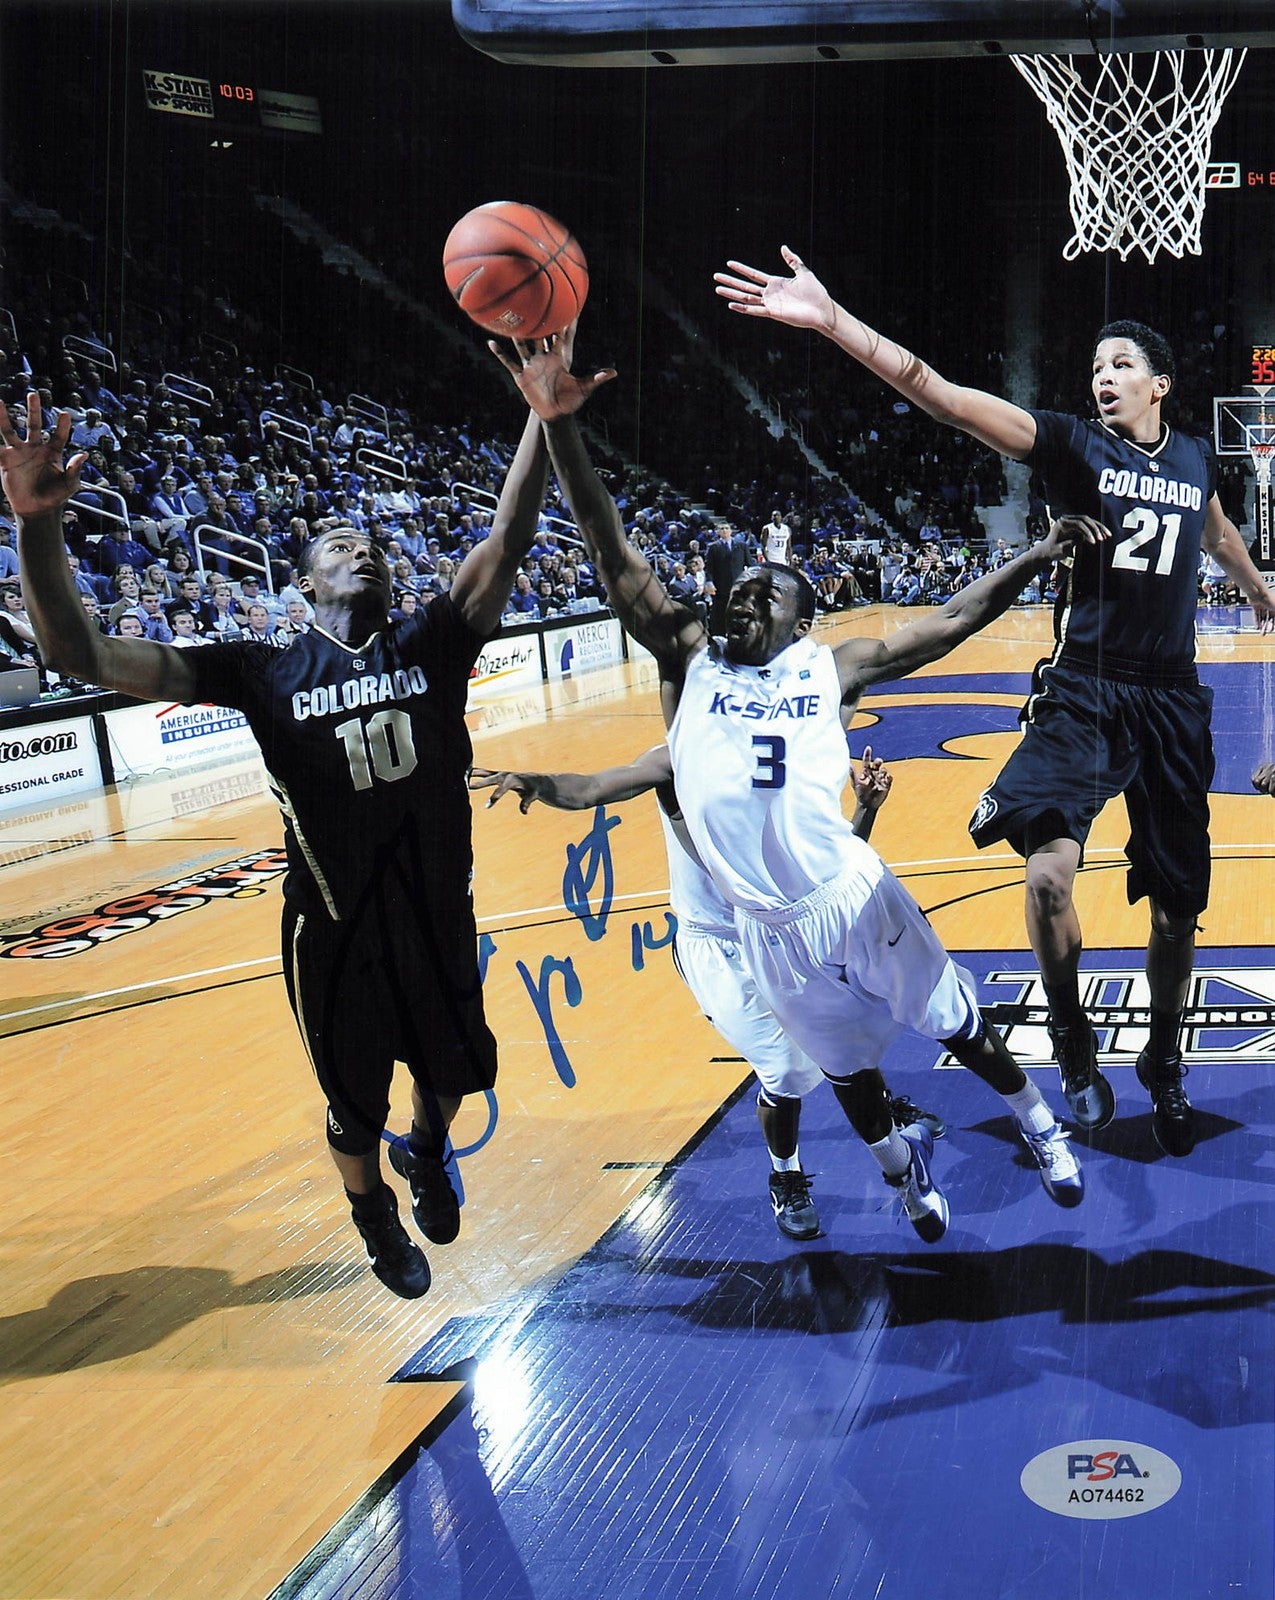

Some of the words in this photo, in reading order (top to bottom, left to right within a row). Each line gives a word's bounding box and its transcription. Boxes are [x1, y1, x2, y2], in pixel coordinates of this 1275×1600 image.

[143, 72, 212, 98] K-STATE
[171, 98, 214, 115] SPORTS
[1247, 171, 1264, 186] 64
[1097, 467, 1203, 512] COLORADO
[1111, 506, 1182, 576] 21
[576, 622, 610, 645] MERCY
[477, 654, 509, 679] Pizza
[510, 646, 534, 667] Hut
[291, 665, 428, 721] COLORADO
[707, 691, 820, 721] K-STATE
[160, 710, 213, 731] AMERICAN
[167, 717, 248, 741] INSURANCE
[334, 708, 418, 791] 10
[751, 735, 787, 789] 3
[51, 768, 85, 783] GRADE
